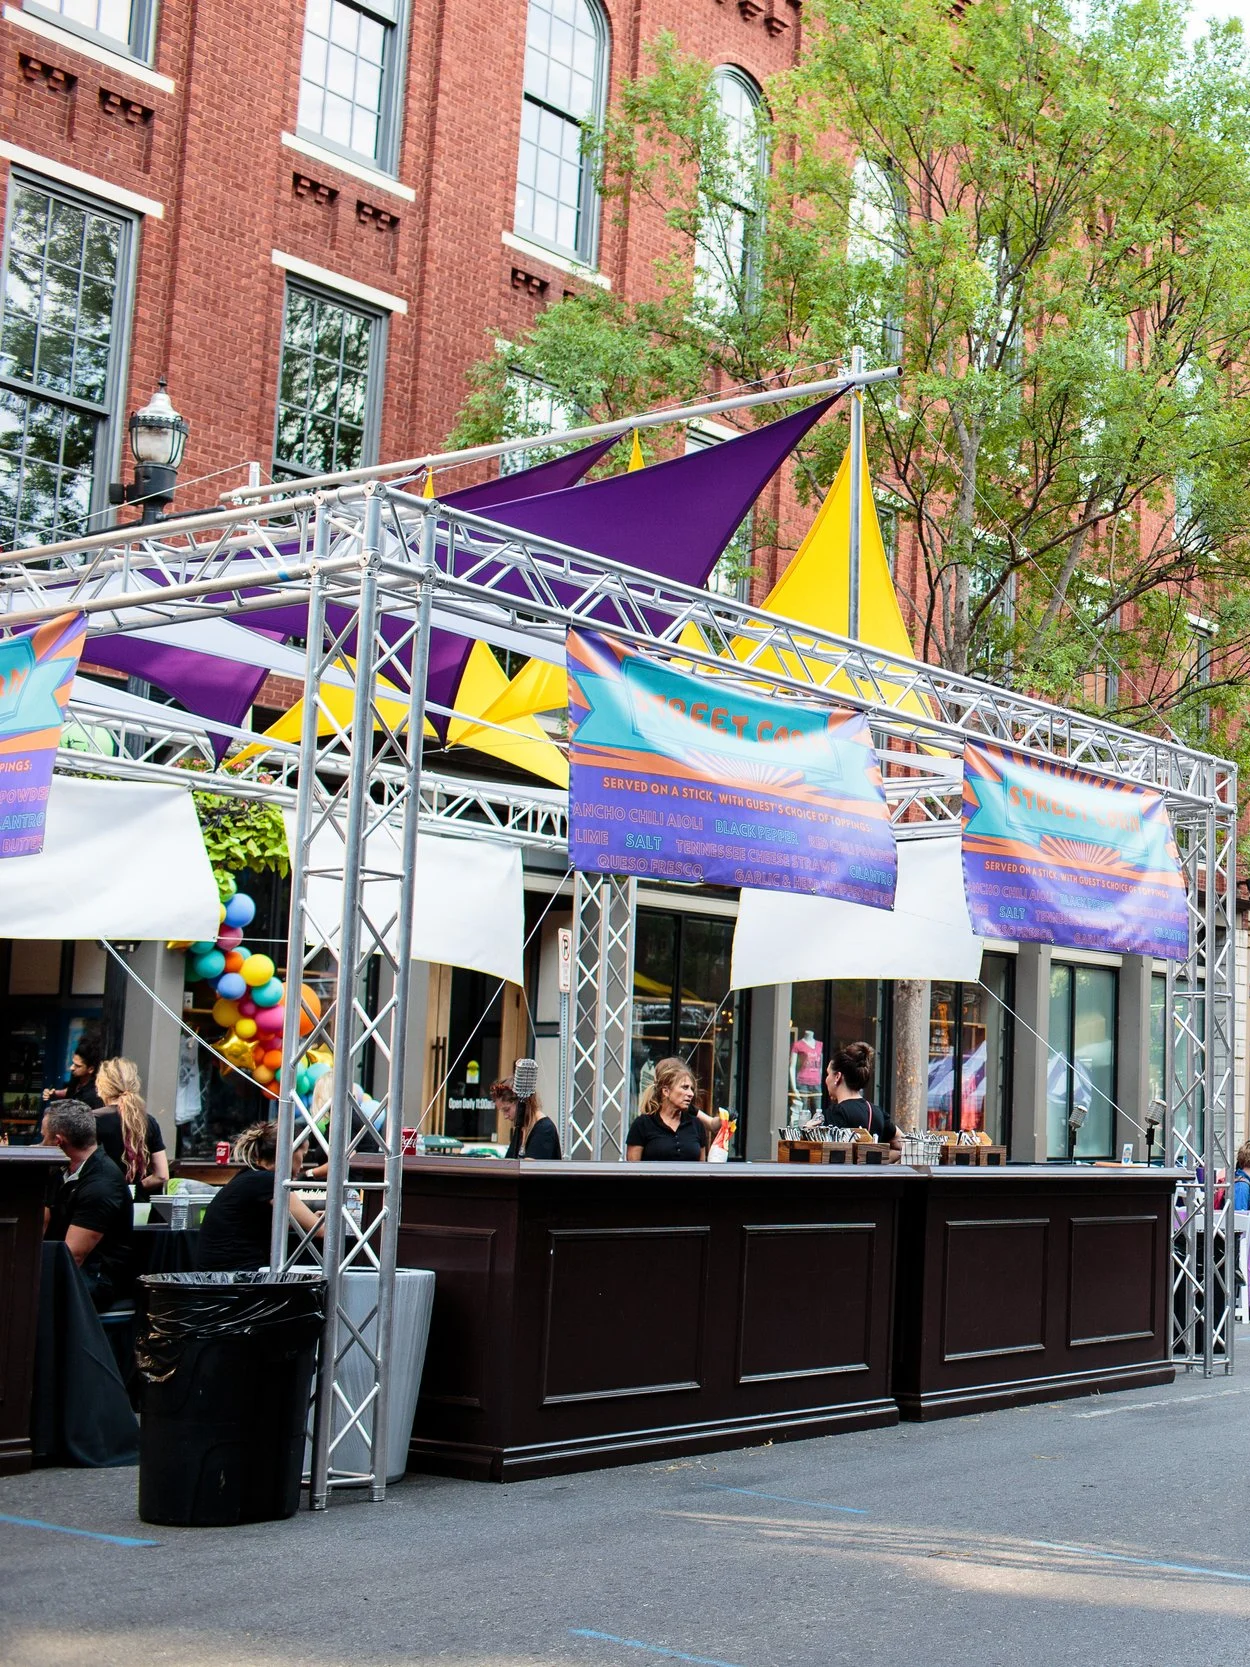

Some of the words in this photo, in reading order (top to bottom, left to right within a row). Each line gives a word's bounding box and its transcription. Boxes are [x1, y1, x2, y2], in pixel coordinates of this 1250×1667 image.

[603, 776, 649, 793] SERVED
[651, 783, 669, 796] ON
[671, 786, 680, 797] A
[682, 787, 717, 804] STICK,
[718, 793, 745, 808] WITH
[745, 798, 785, 815] GUEST'S
[785, 805, 818, 822] CHOICE
[818, 811, 830, 823] OF
[1007, 785, 1089, 823] STREET
[1096, 807, 1141, 833] CORN
[572, 801, 627, 822] ANCHO
[628, 808, 664, 826] CHILI
[666, 813, 704, 831] AIOLI
[715, 819, 757, 839] BLACK
[757, 825, 800, 845] PEPPER
[575, 828, 609, 846] LIME
[625, 832, 662, 851] SALT
[676, 839, 746, 860] TENNESSEE
[748, 848, 791, 869] CHEESE
[791, 854, 840, 875] STRAWS
[849, 864, 893, 887] CILANTRO
[597, 853, 650, 872] QUESO
[650, 858, 704, 878] FRESCO
[735, 868, 780, 887] GARLIC
[781, 875, 791, 888] &
[984, 860, 1018, 874] SERVED
[1018, 864, 1032, 876] ON
[1031, 867, 1038, 877] A
[1060, 872, 1078, 885] WITH
[1079, 875, 1106, 889] GUEST'S
[1106, 879, 1129, 892] CHOICE
[1128, 883, 1138, 894] OF
[999, 905, 1026, 920] SALT
[449, 1097, 463, 1110] Open
[463, 1097, 475, 1111] Daily
